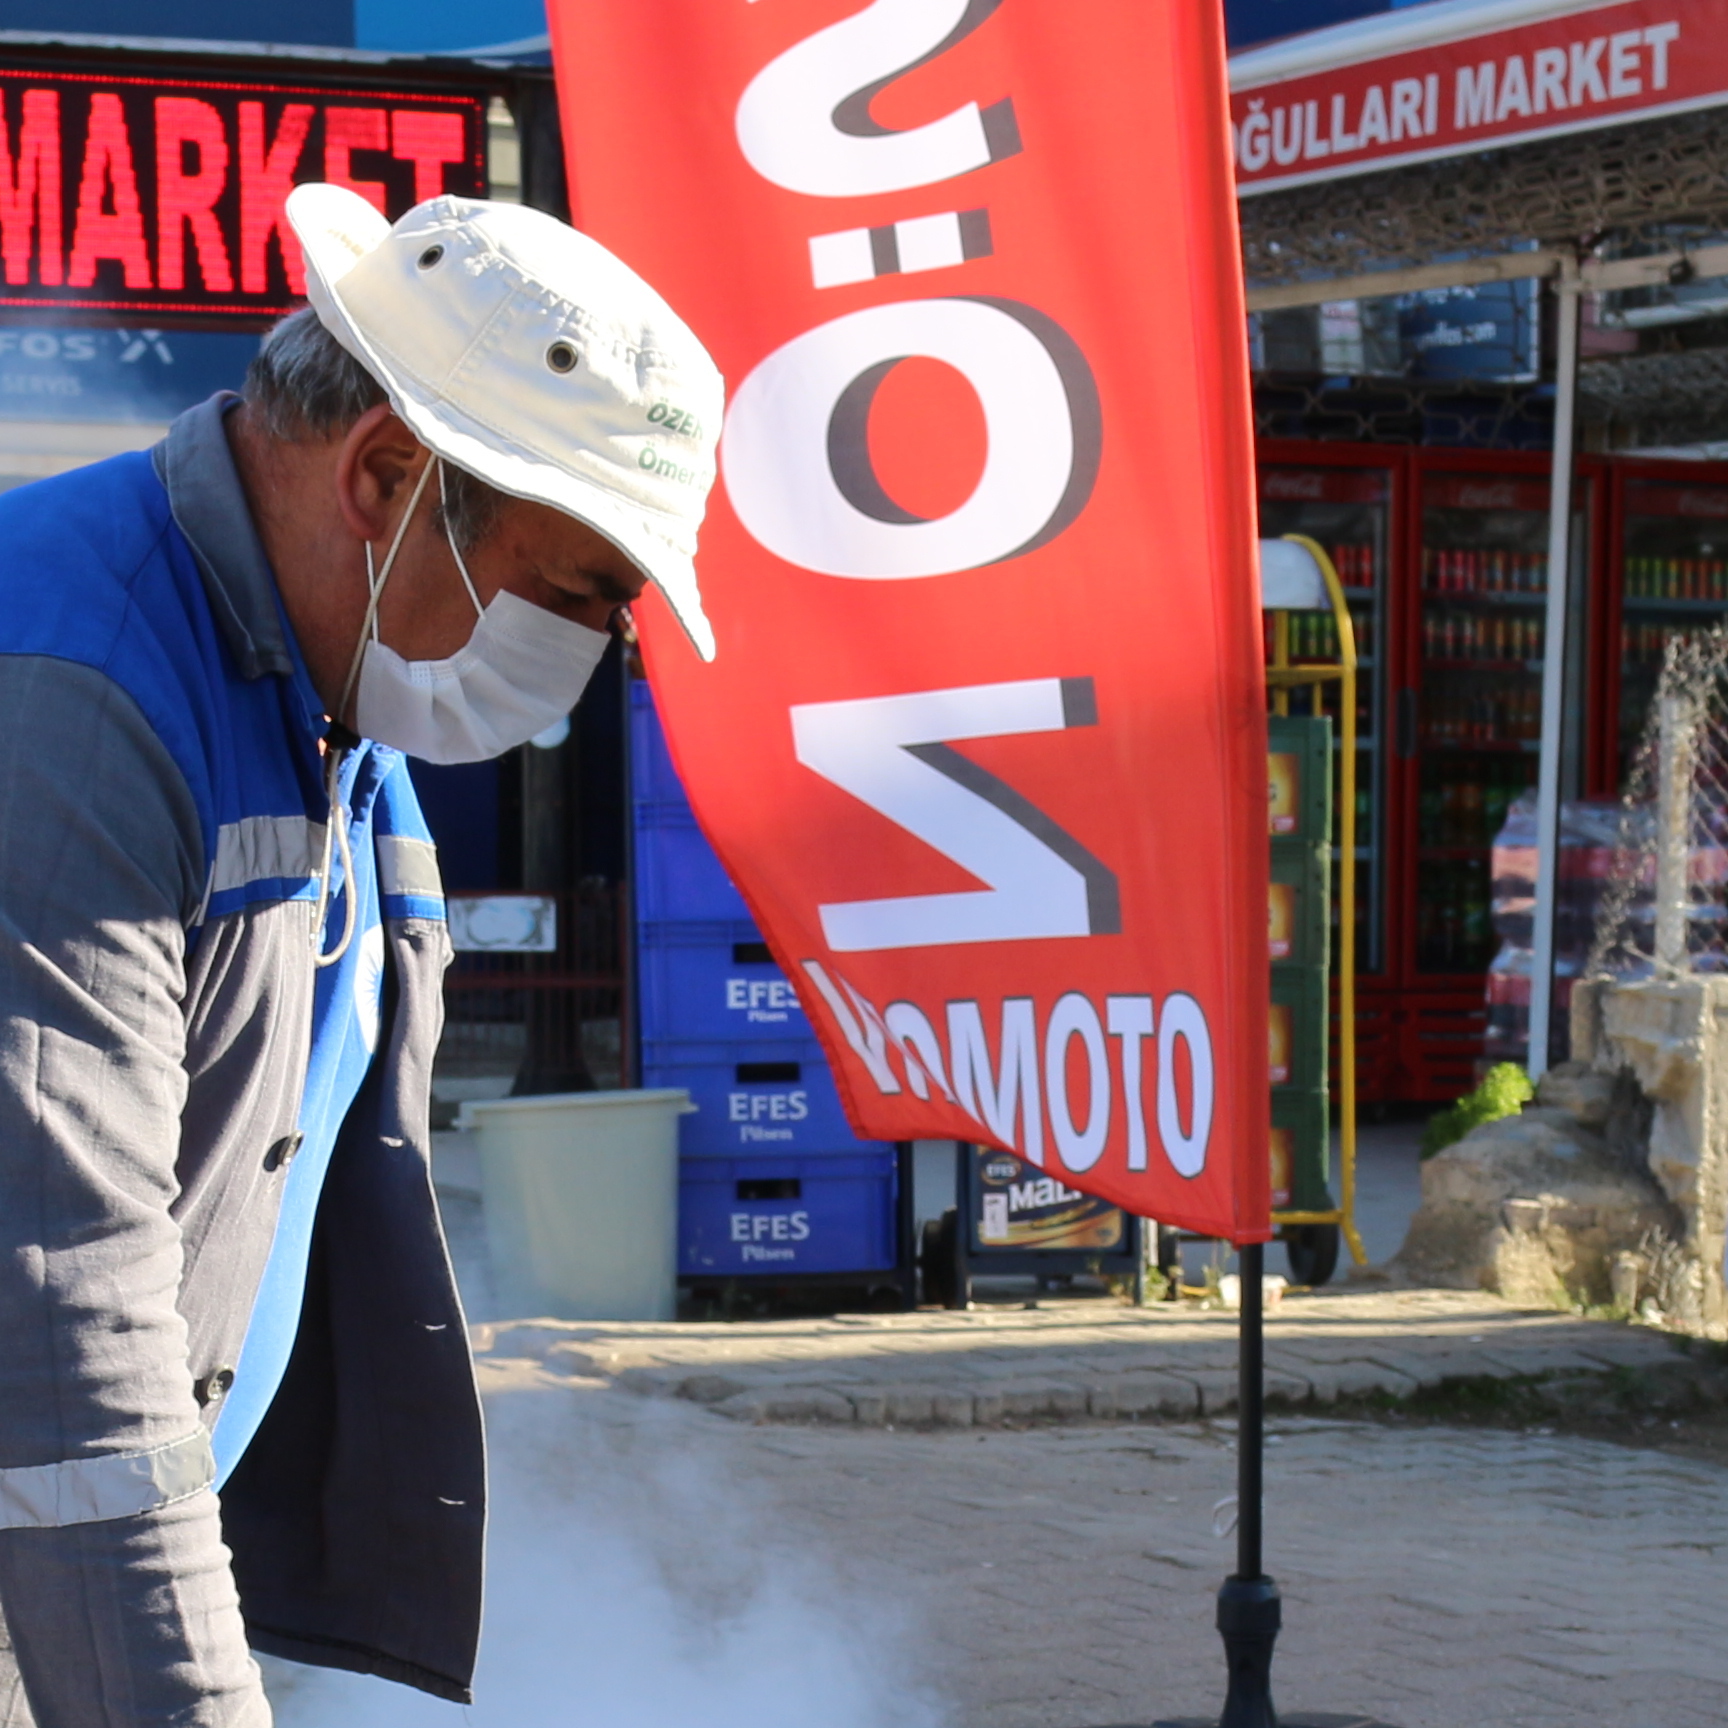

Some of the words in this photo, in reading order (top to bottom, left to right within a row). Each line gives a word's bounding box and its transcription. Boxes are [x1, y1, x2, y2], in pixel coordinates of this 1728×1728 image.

[1453, 20, 1680, 131] MARKET
[729, 1090, 808, 1122] EFES
[730, 1211, 811, 1242] EFES
